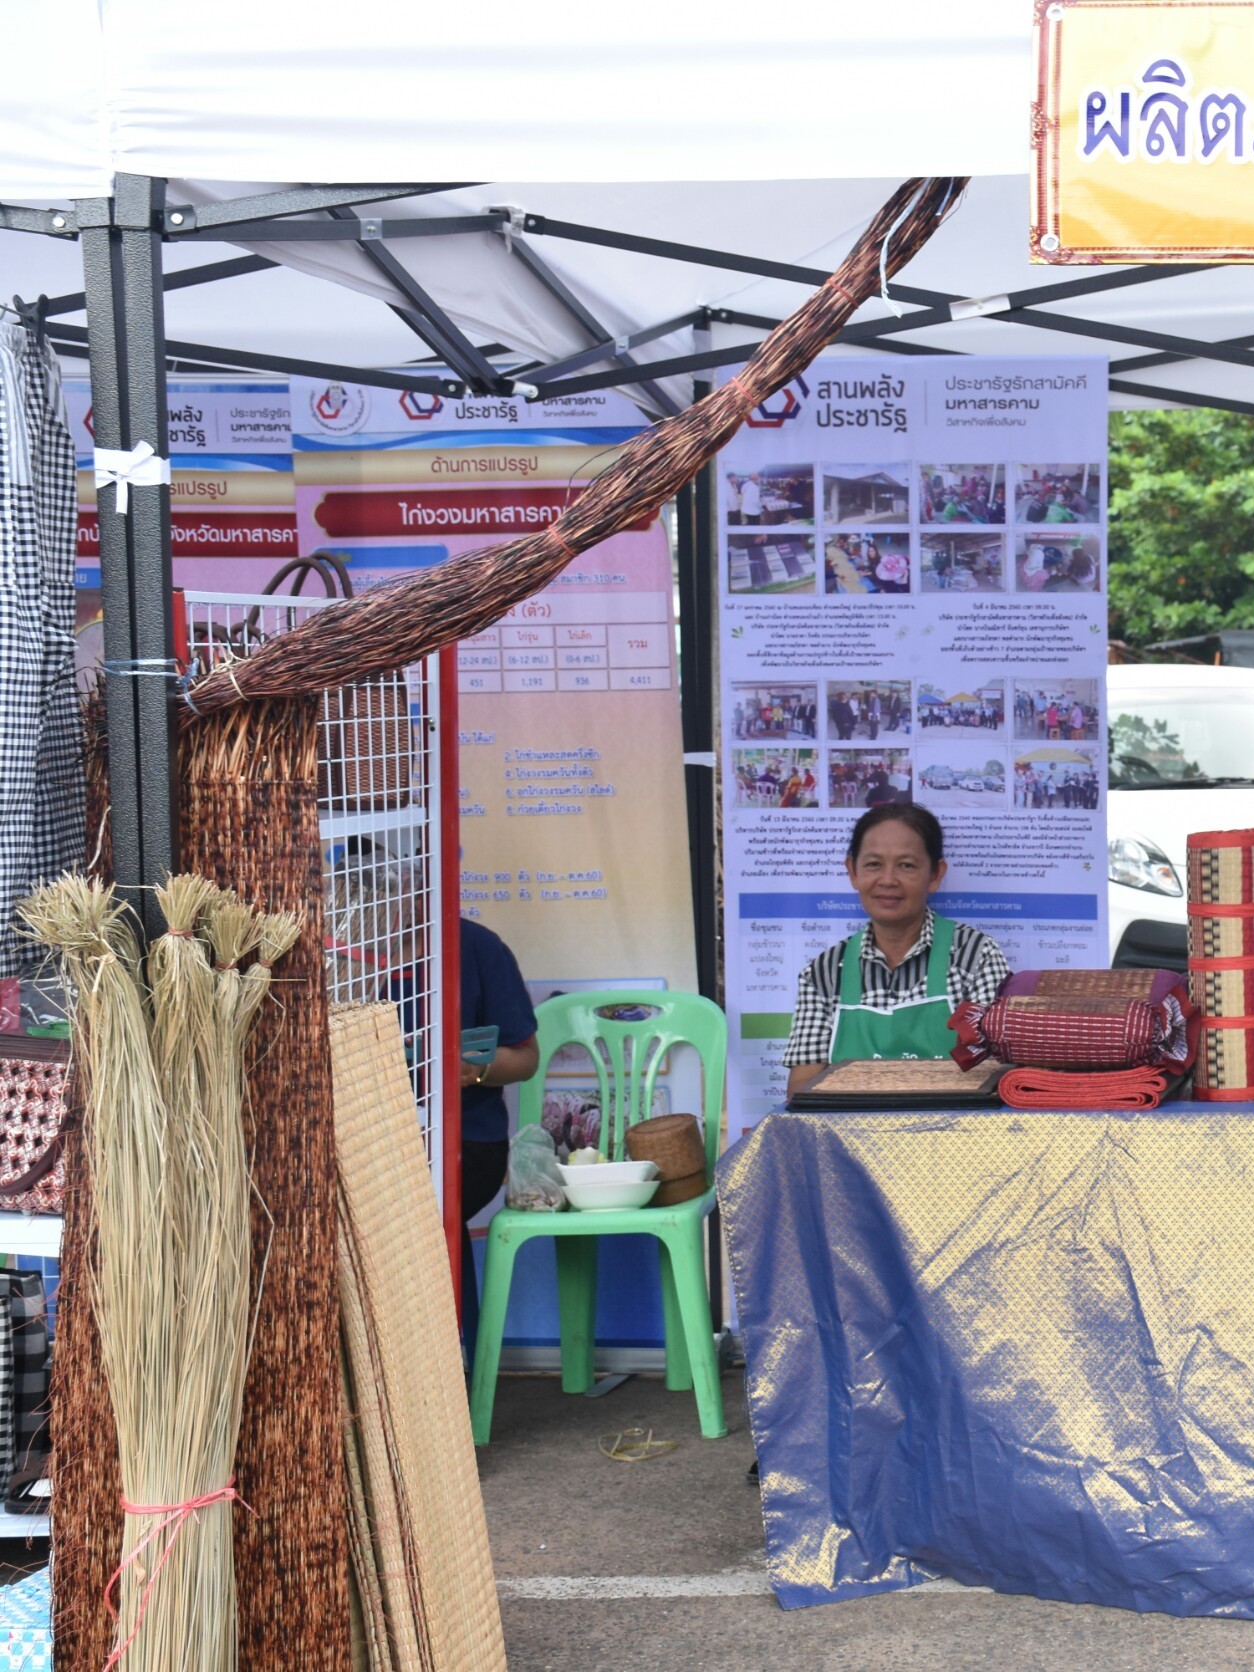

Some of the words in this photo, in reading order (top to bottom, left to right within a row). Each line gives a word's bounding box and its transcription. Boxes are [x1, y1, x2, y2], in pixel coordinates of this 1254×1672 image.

[818, 374, 904, 399] สานพลัง
[945, 375, 1087, 393] ประชารัฐรักสามัคคี
[455, 401, 518, 422] ประชารัฐ
[946, 397, 1040, 410] มหาสารคาม
[816, 403, 907, 432] ประชารัฐ
[431, 456, 538, 476] ด้านการแปรรูป
[627, 640, 647, 649] รวม
[494, 871, 511, 881] 900
[493, 889, 510, 899] 650
